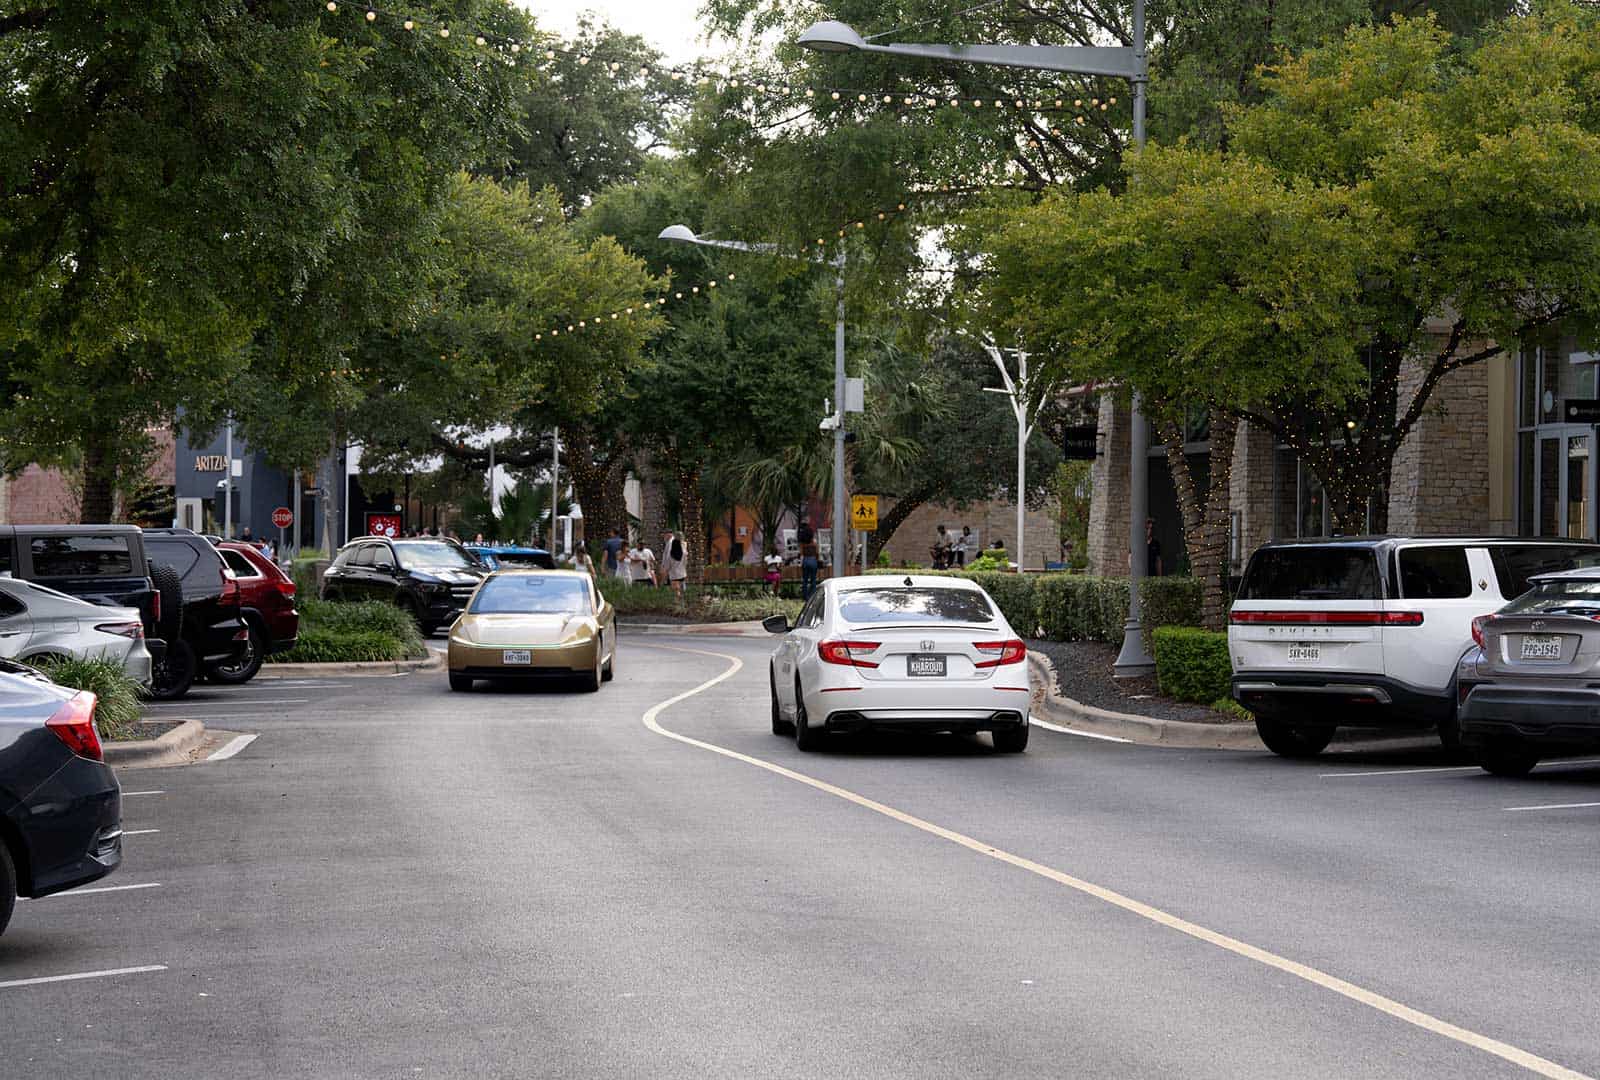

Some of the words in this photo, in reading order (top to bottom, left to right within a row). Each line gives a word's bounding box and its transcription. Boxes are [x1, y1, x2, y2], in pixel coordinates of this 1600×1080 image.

[194, 456, 229, 471] ARITZIA
[272, 513, 292, 522] STOP
[911, 661, 944, 673] KHAROUD
